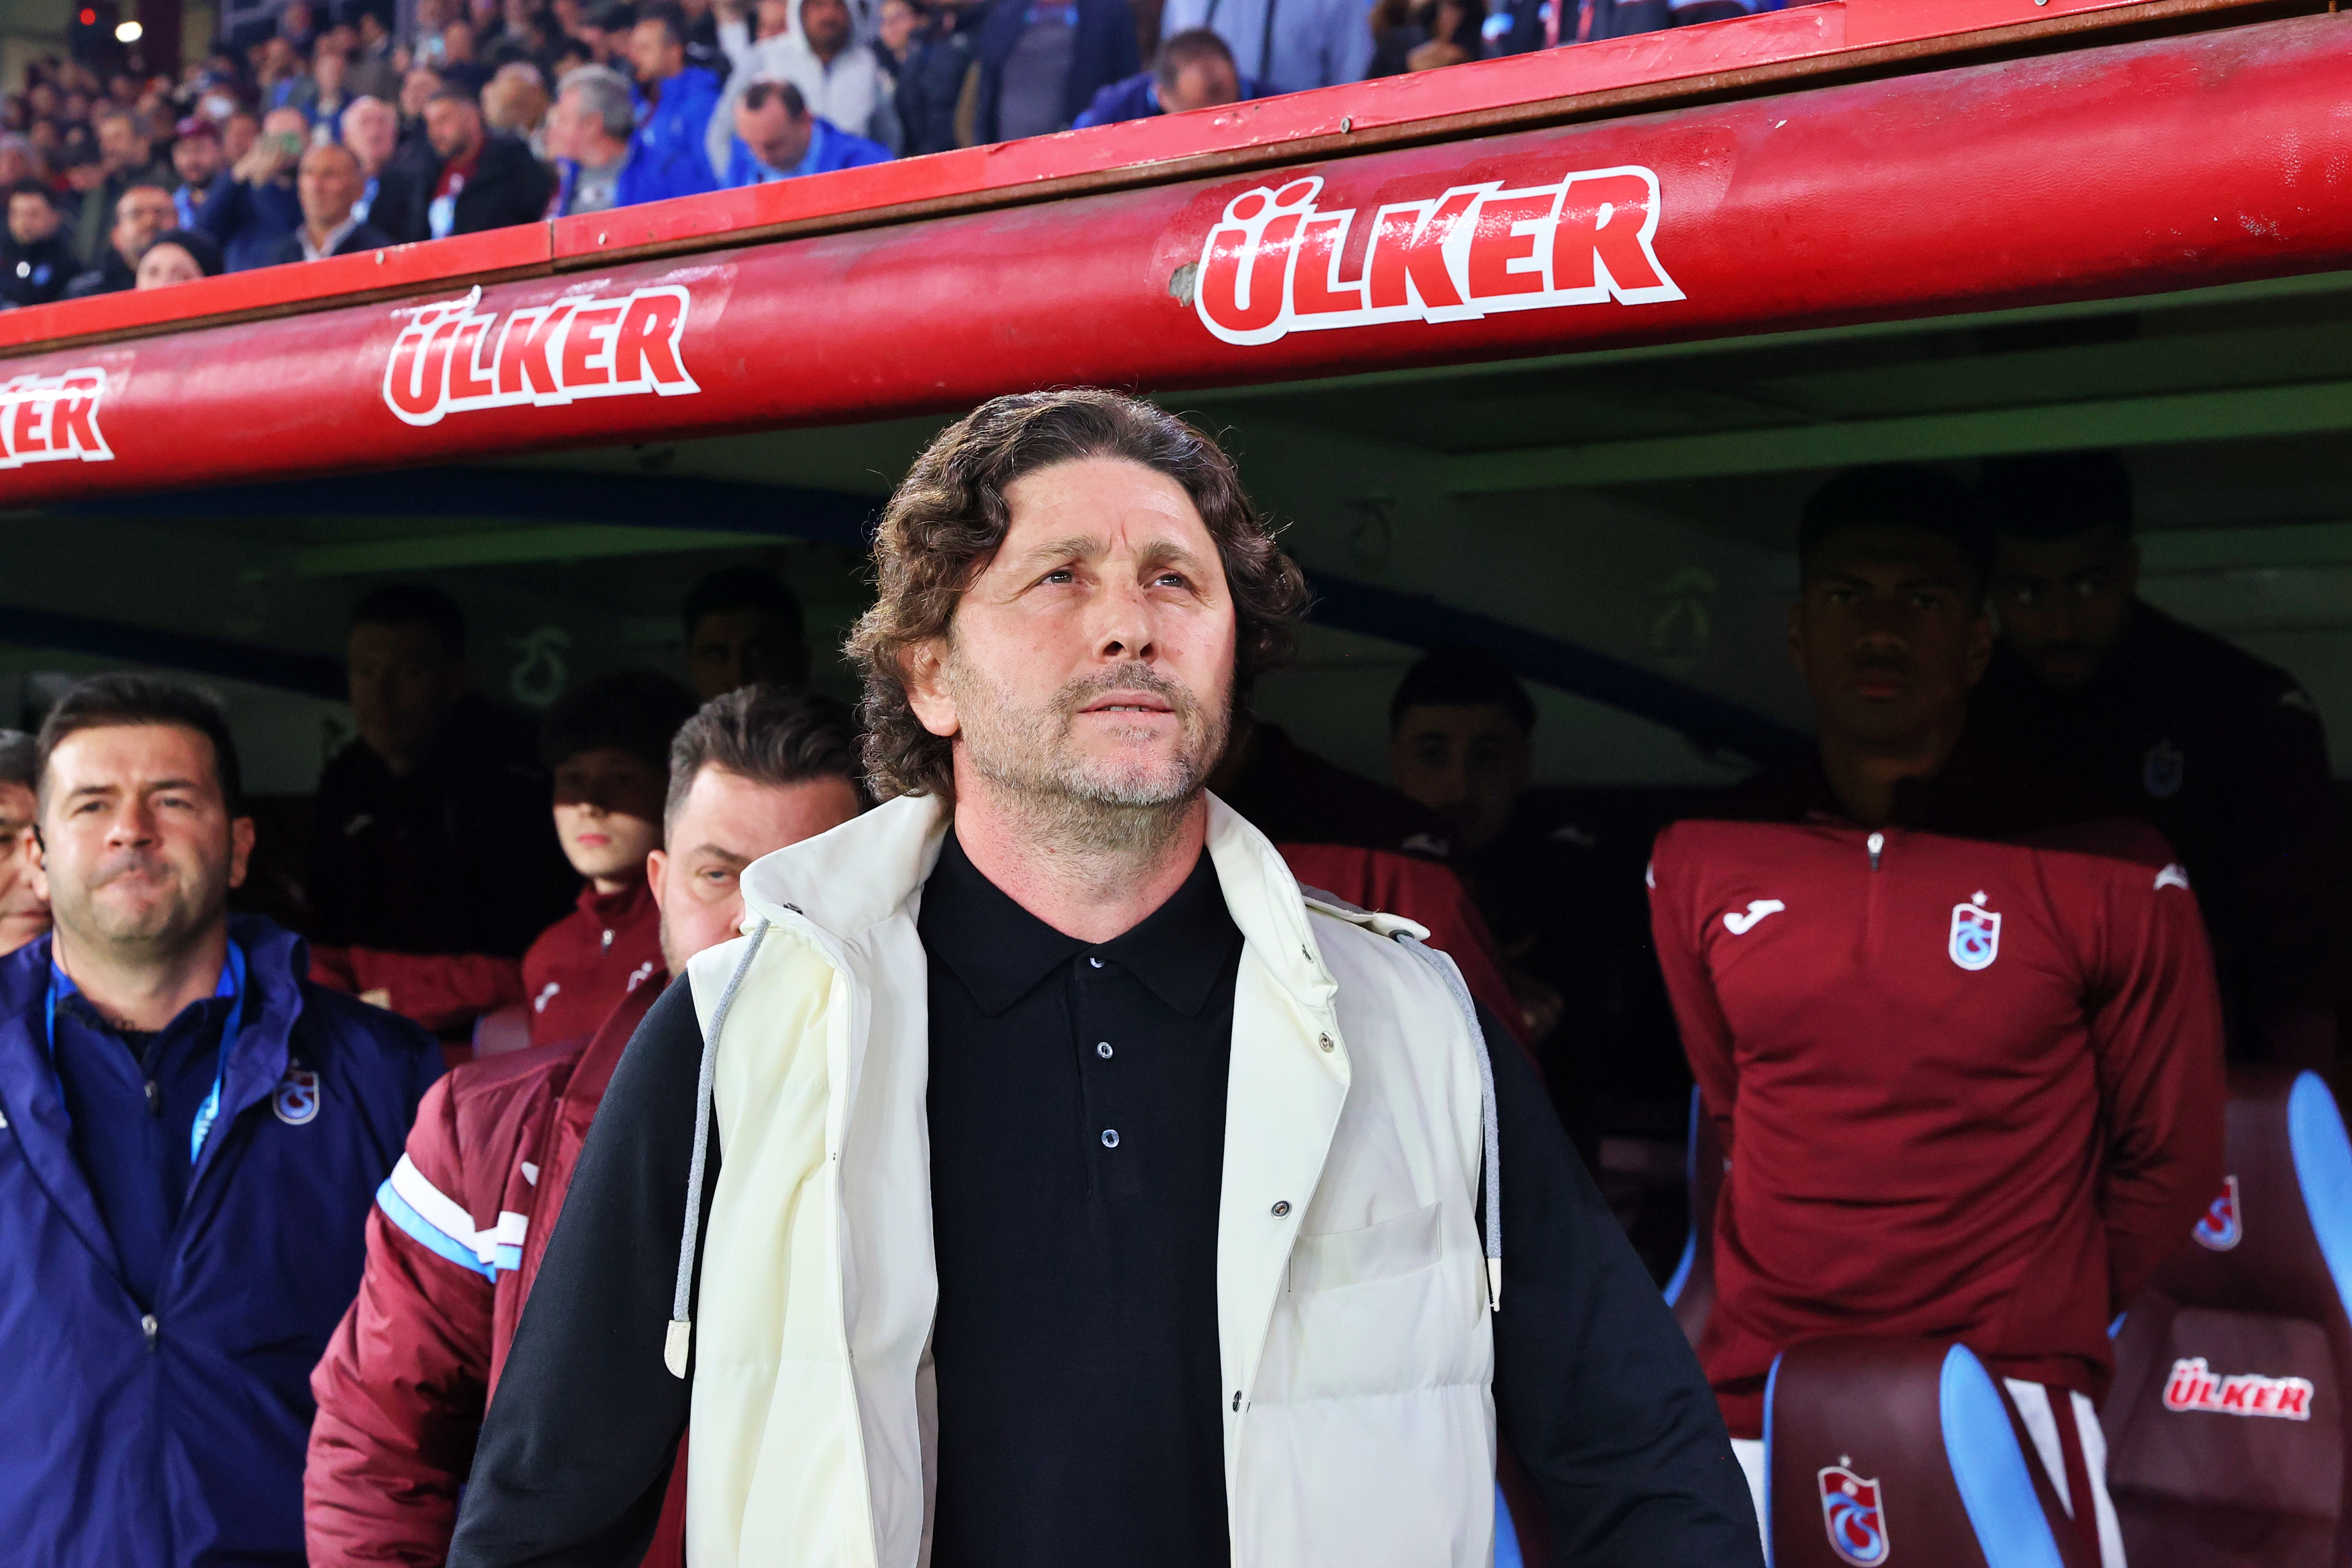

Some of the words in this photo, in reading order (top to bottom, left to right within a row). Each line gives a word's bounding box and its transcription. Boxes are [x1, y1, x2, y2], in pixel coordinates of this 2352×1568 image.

[1197, 168, 1681, 344] ÜLKER
[384, 285, 699, 423] ÜLKER
[2165, 1361, 2312, 1418] ÜLKER
